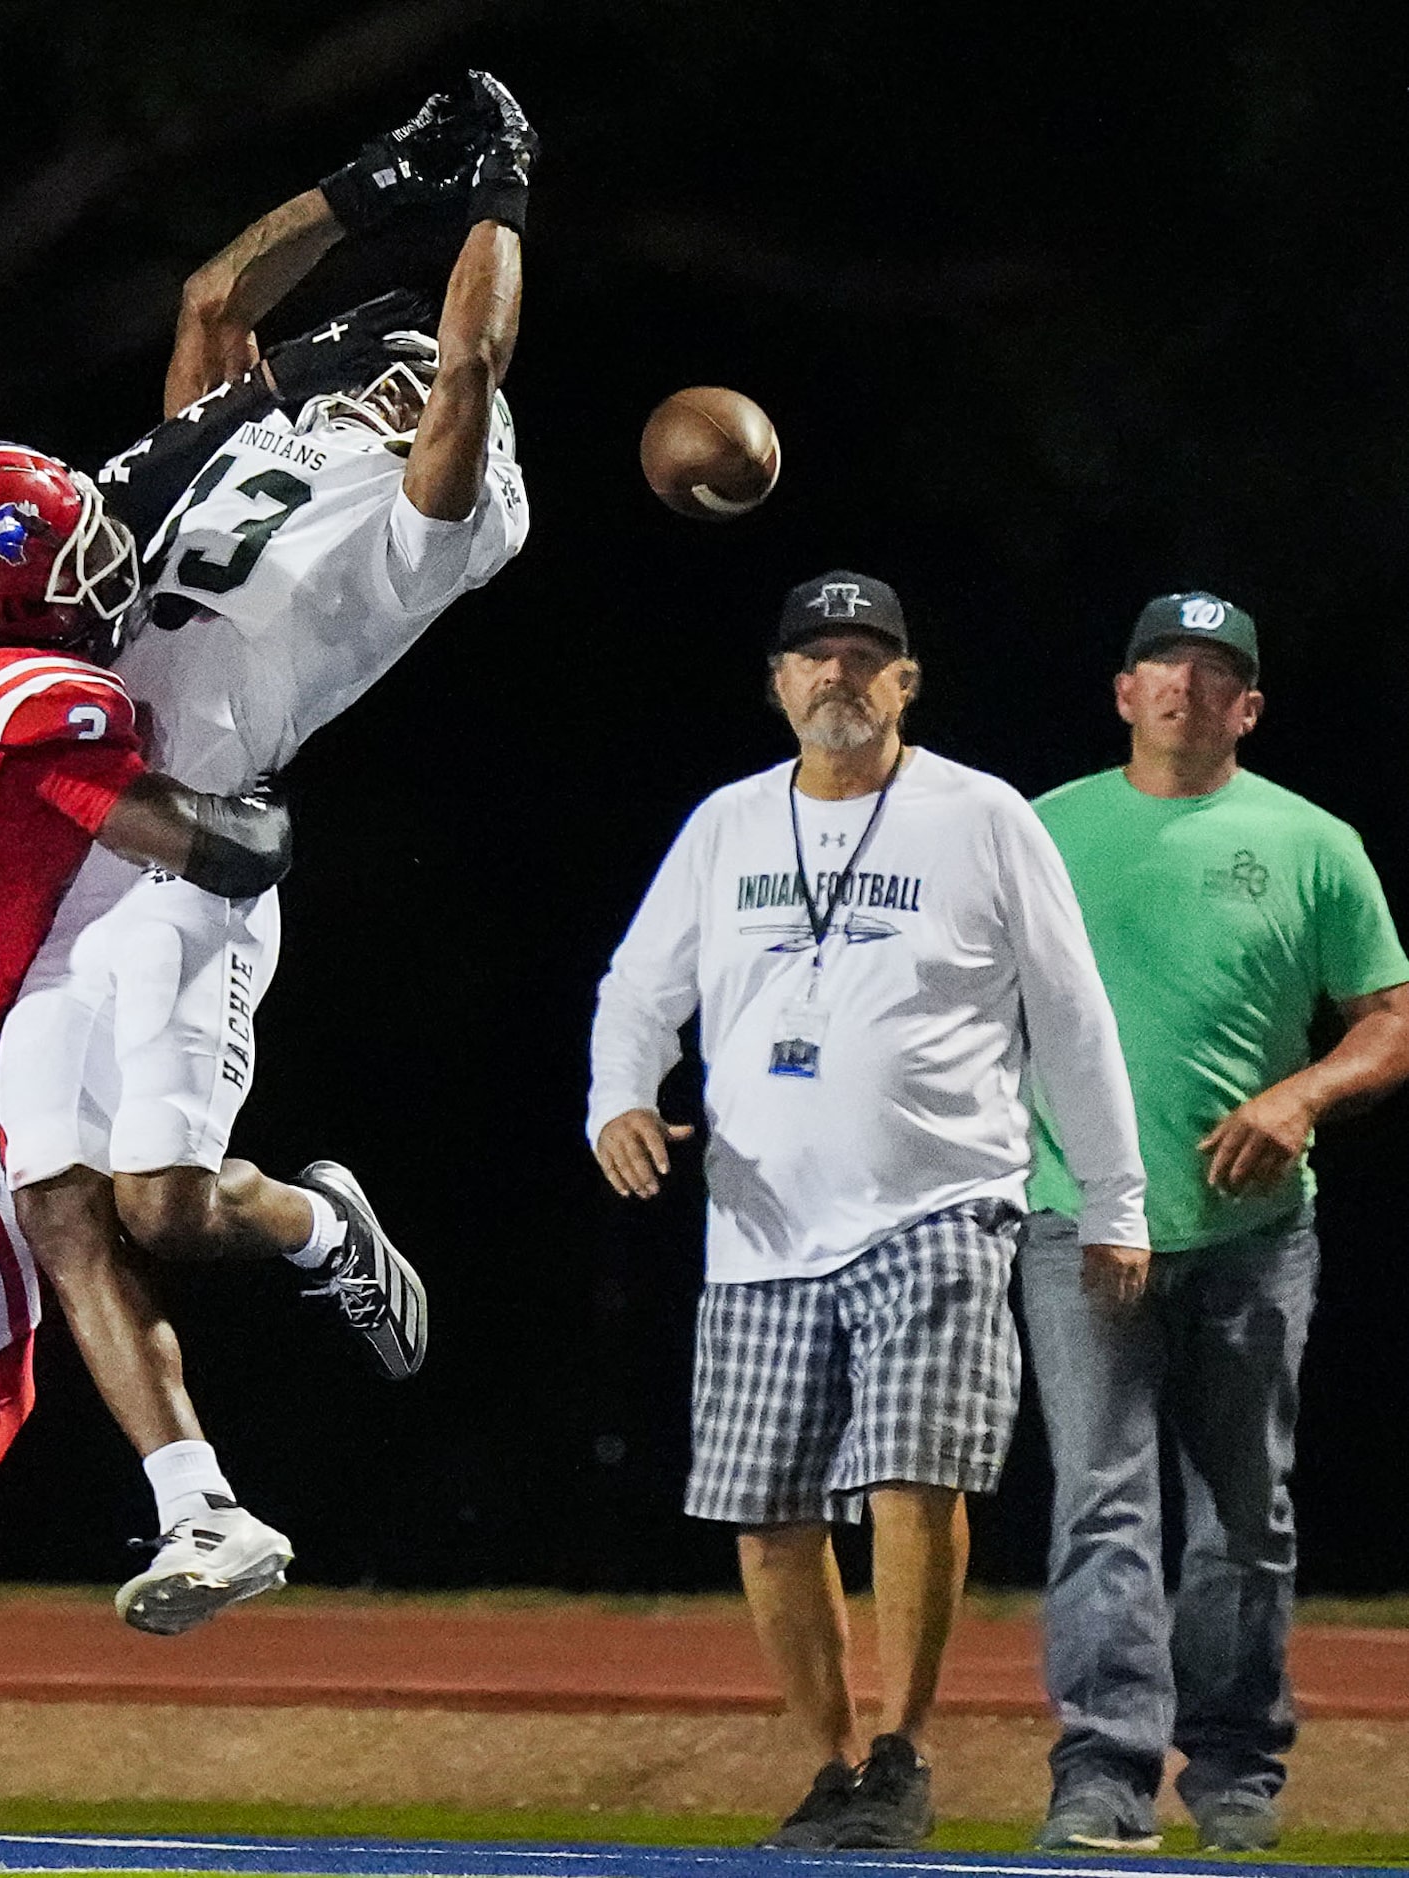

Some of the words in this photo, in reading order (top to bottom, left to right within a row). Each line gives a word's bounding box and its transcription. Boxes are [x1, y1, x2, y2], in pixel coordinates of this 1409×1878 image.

[239, 424, 327, 471] INDIANS
[164, 453, 312, 595] 13
[817, 872, 921, 912] FOOTBALL
[222, 952, 253, 1090] HACHIE
